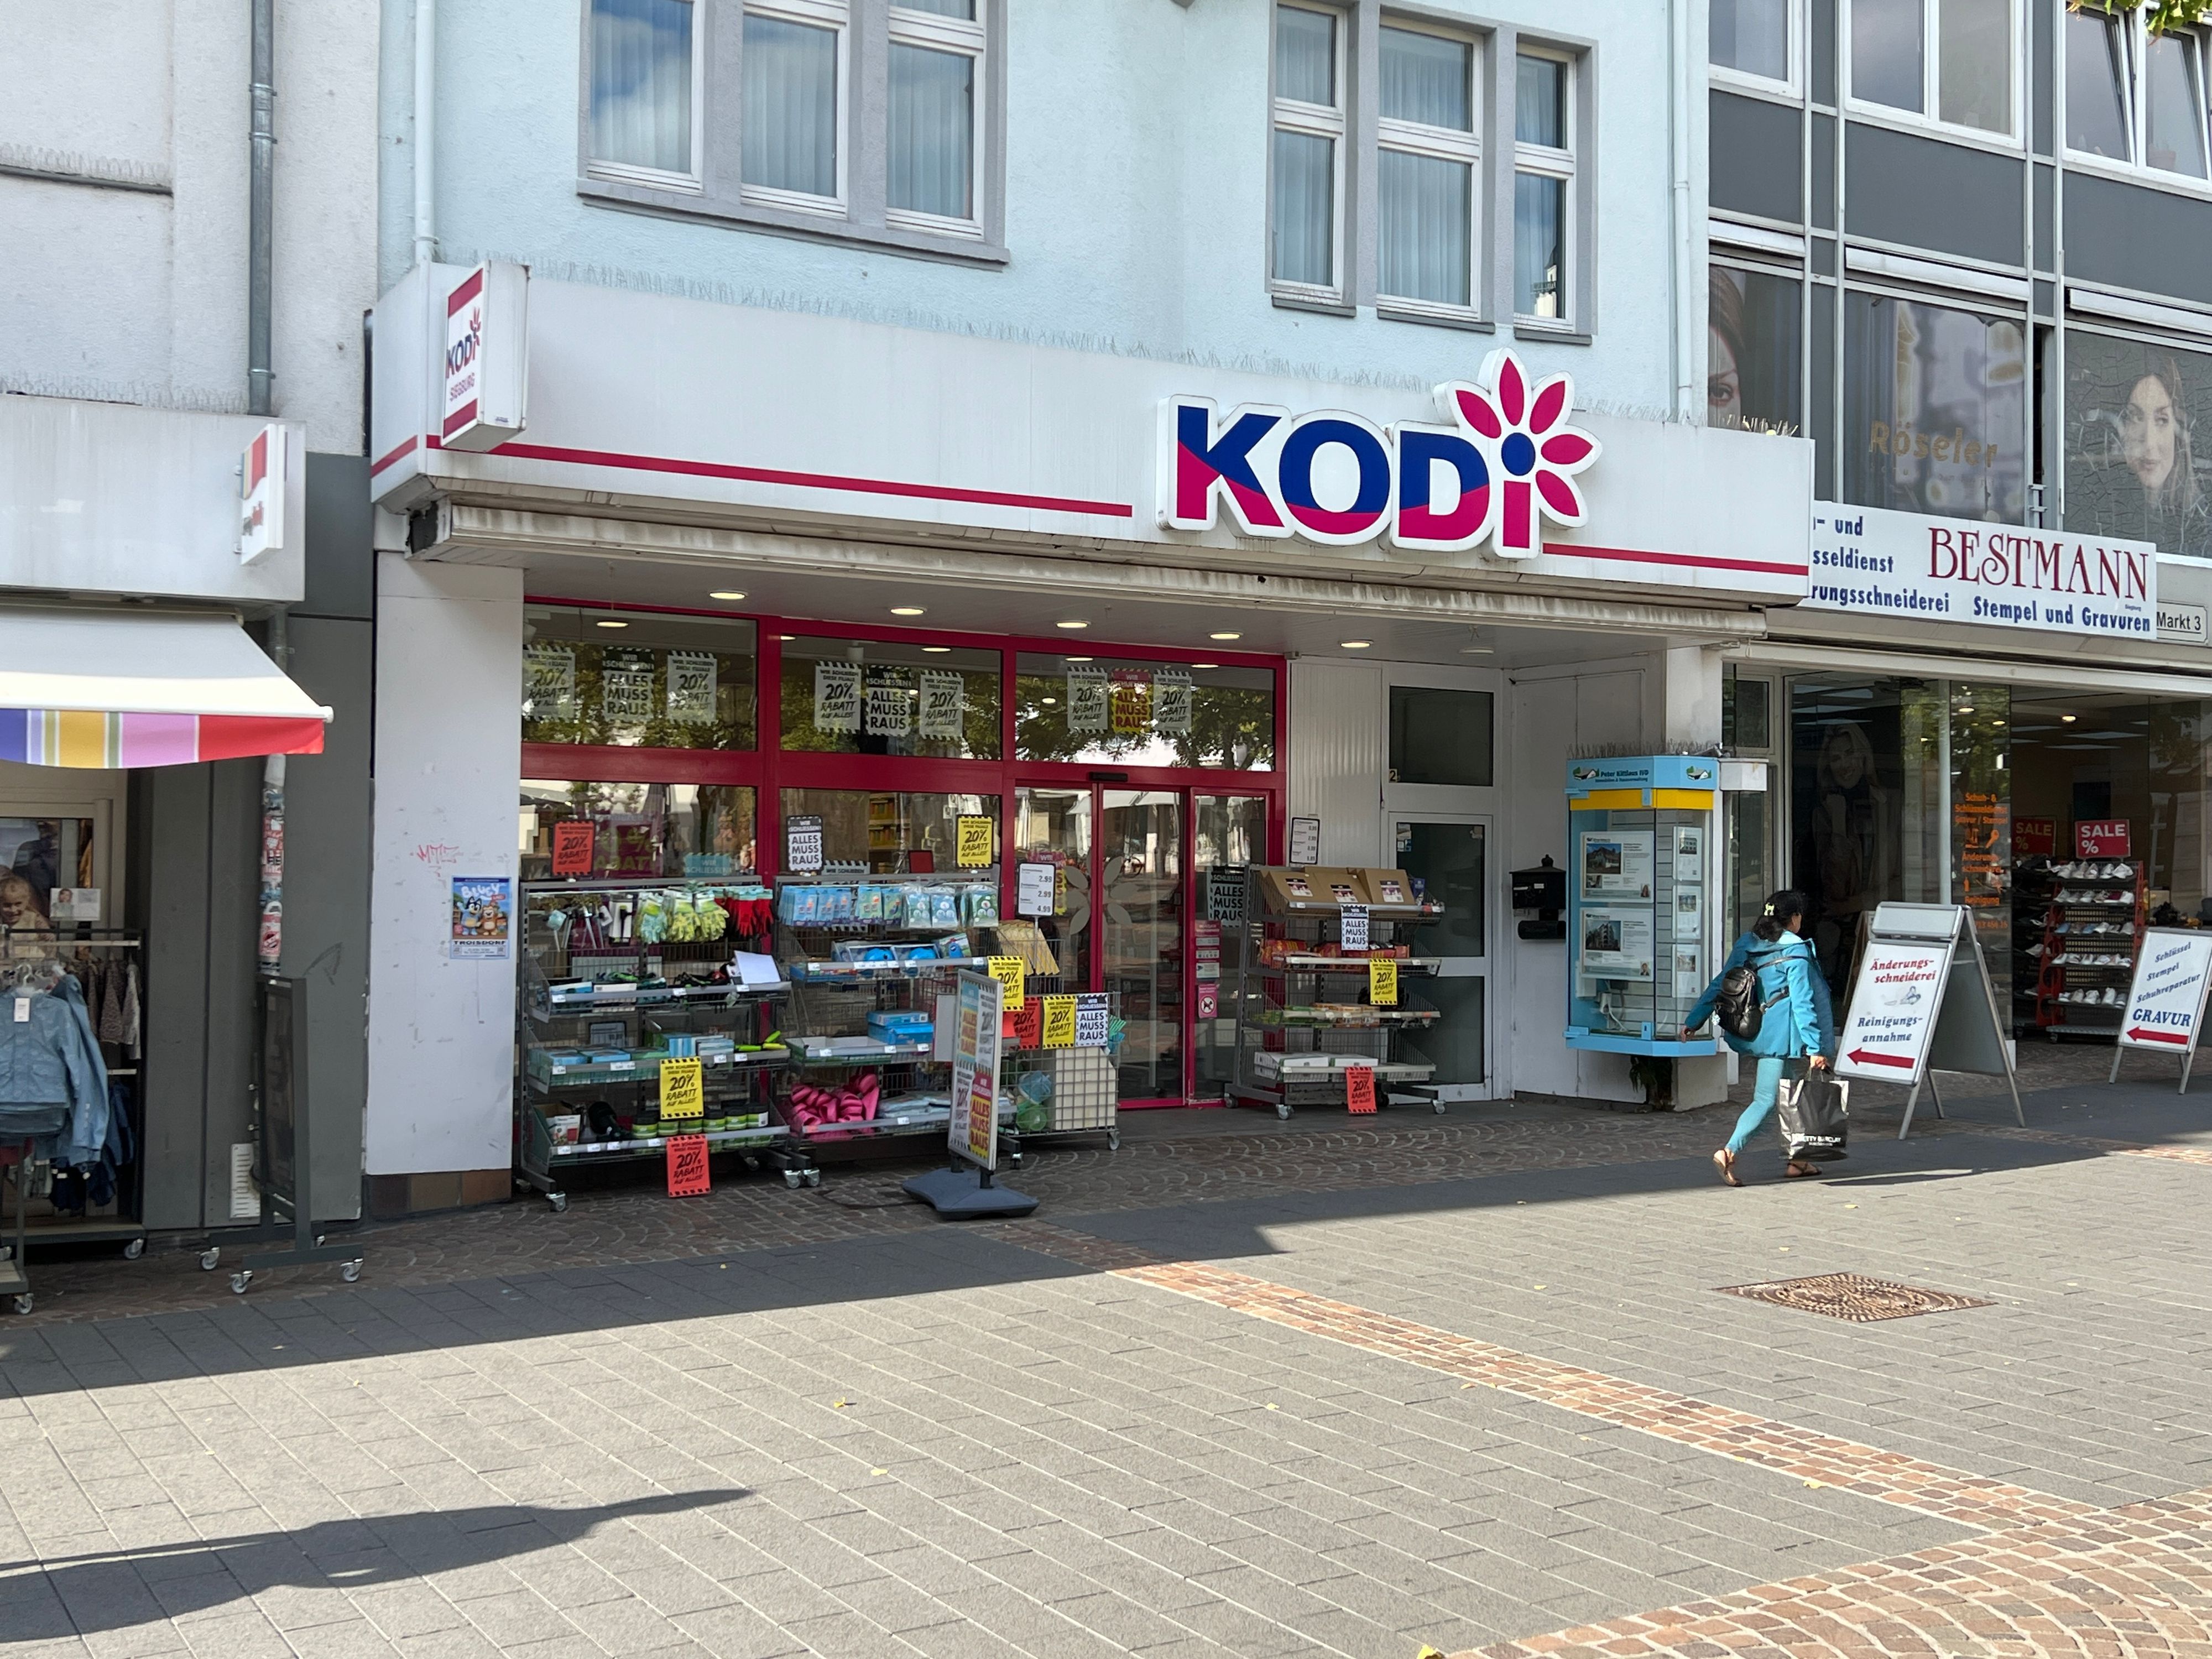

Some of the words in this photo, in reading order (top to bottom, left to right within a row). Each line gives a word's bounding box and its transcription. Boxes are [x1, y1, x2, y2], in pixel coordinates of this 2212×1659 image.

[1869, 420, 1998, 468] Röseler
[1835, 515, 1864, 536] und
[1813, 546, 1893, 573] sseldienst
[1927, 527, 2150, 602] BESTMANN
[1812, 585, 1949, 612] rungsschneiderei
[1973, 596, 2037, 623] Stempel
[2046, 604, 2074, 624] und
[2081, 607, 2151, 632] Gravuren
[2157, 611, 2192, 630] Markt
[2194, 615, 2201, 631] 3
[608, 688, 649, 701] MUSS
[825, 682, 853, 701] 20%
[870, 690, 906, 703] ALLES
[928, 691, 957, 708] 20%
[608, 702, 649, 716] RAUS
[870, 703, 906, 717] MUSS
[1115, 703, 1148, 716] MUSS
[870, 716, 906, 730] RAUS
[2015, 822, 2053, 836] SALE
[2080, 823, 2126, 838] SALE
[561, 835, 588, 851] 20%
[791, 834, 818, 844] ALLES
[964, 830, 987, 843] 20%
[791, 844, 819, 854] MUSS
[2081, 839, 2099, 854] %
[791, 854, 820, 865] RAUS
[1214, 886, 1244, 898] ALLES
[1213, 898, 1244, 909] MUSS
[1213, 910, 1244, 921] RAUS
[2154, 941, 2192, 963] Schlüssel
[1870, 957, 1935, 971] Änderungs-
[1376, 972, 1392, 984] 20%
[1874, 970, 1937, 983] schneiderei
[2146, 962, 2180, 982] Stempel
[2136, 973, 2201, 1003] Schuhreparatur
[1050, 1009, 1071, 1025] 20%
[1079, 1012, 1104, 1021] ALLES
[1858, 1016, 1924, 1029] Reinigungs-
[2132, 1008, 2192, 1027] GRAVUR
[1079, 1021, 1104, 1030] MUSS
[1079, 1030, 1104, 1040] RAUS
[1862, 1032, 1912, 1043] annahme
[670, 1073, 695, 1091] 20%
[666, 1088, 698, 1101] RABATT
[676, 1150, 702, 1169] 20%
[674, 1165, 705, 1178] RABATT
